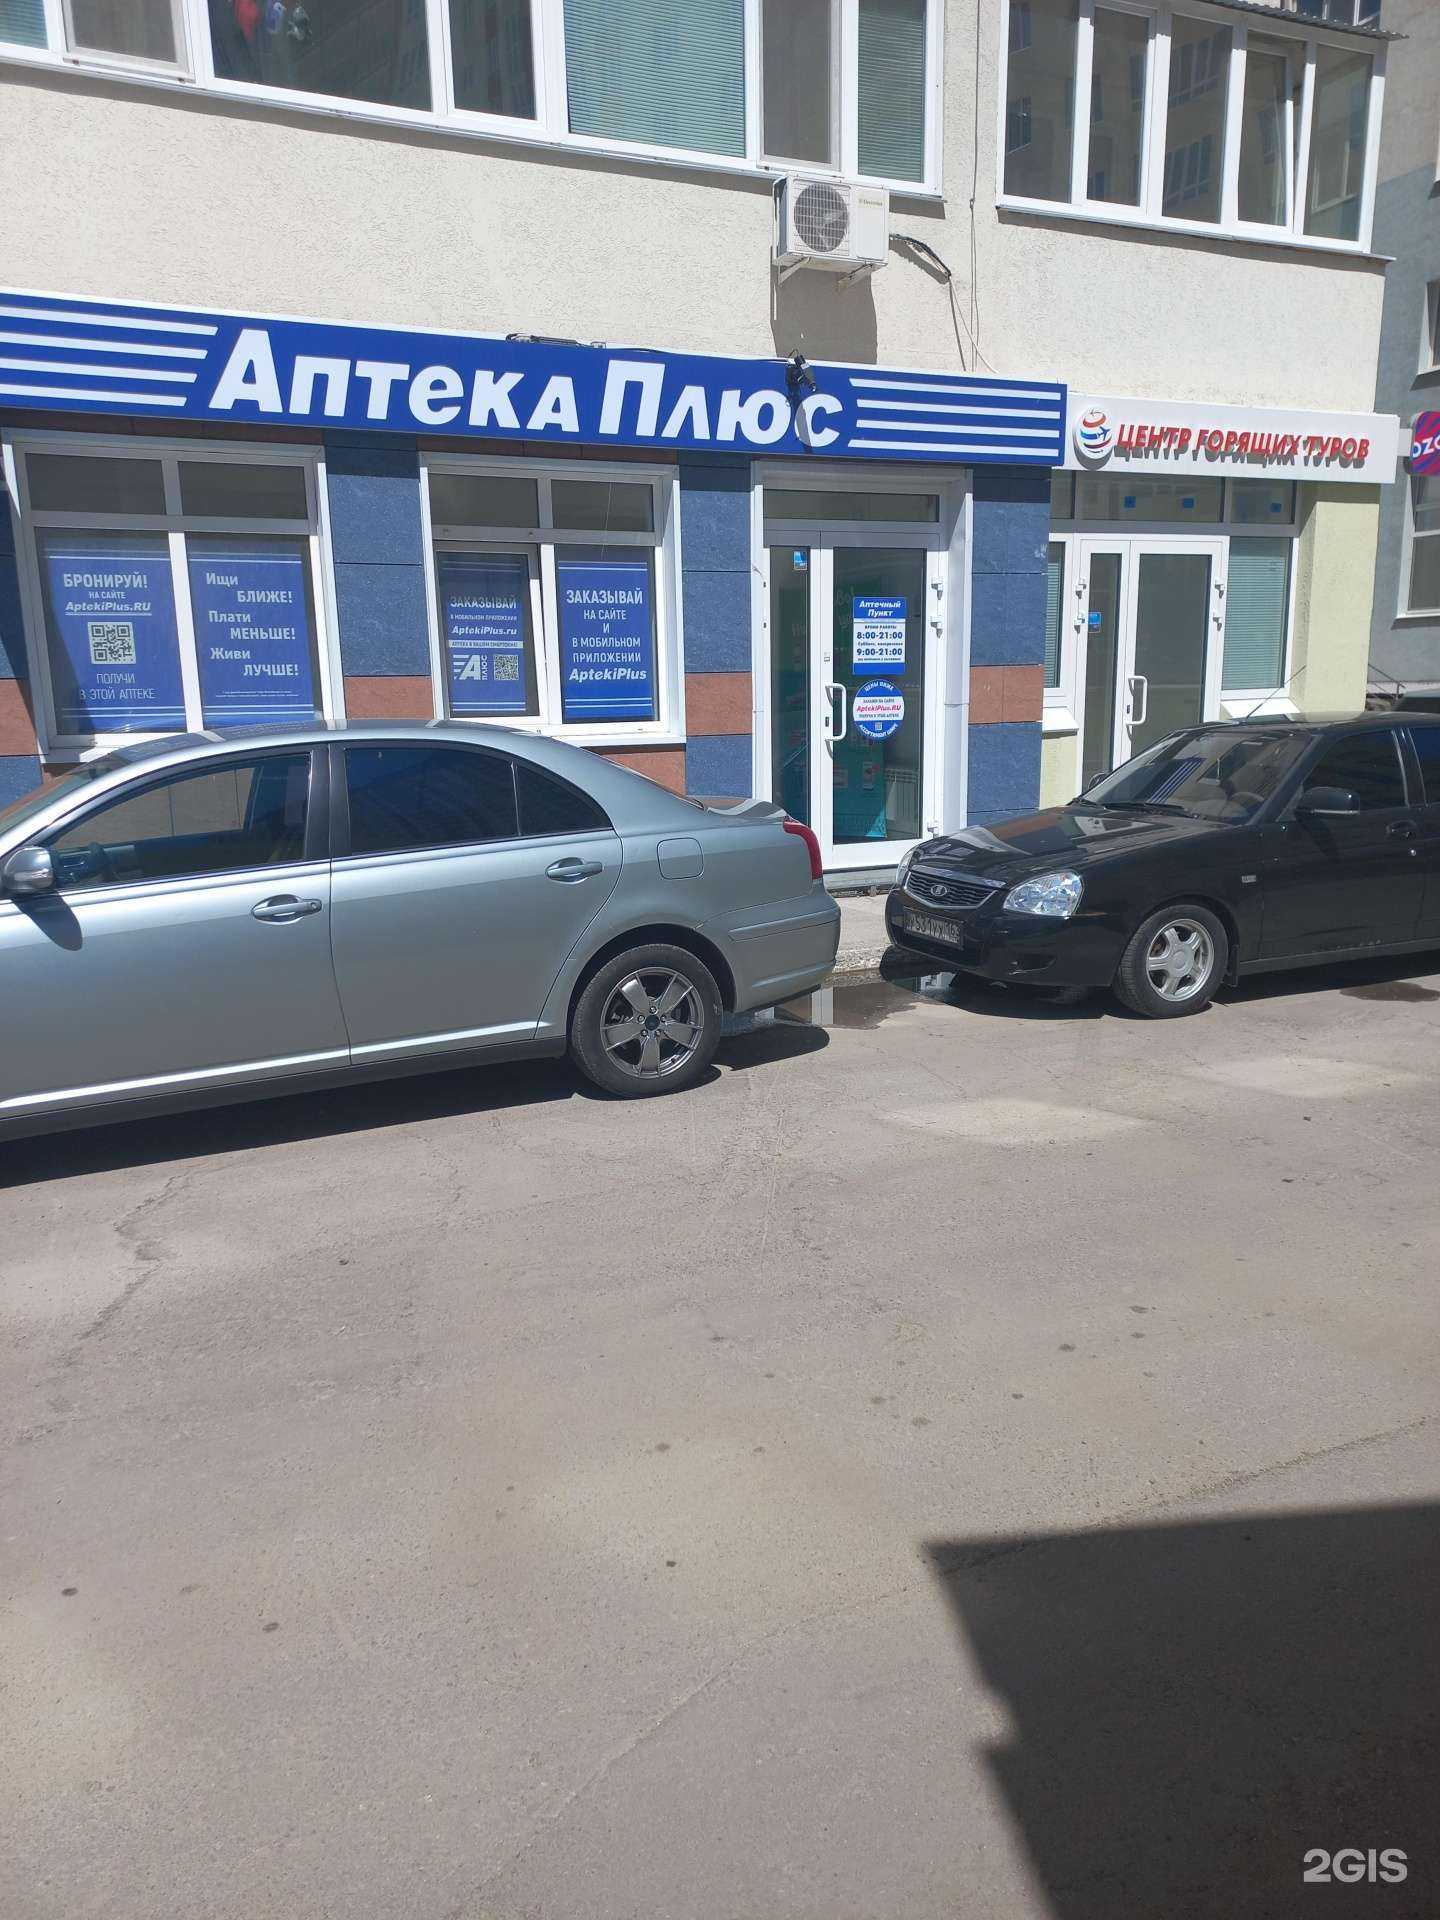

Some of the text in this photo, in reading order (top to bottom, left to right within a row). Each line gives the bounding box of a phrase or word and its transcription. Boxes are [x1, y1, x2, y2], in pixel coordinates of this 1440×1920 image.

[1117, 424, 1370, 460] ЦЕНТР ГОРЯЩИХ ТУРОВ
[63, 572, 148, 588] БРОНИРУЙ!
[206, 572, 239, 587] Ищи
[89, 591, 100, 599] НА
[237, 590, 293, 603] БЛИЖЕ!
[566, 588, 643, 604] ЗАКАЗЫВАЙ
[65, 601, 151, 613] AptekiPlus.RU
[450, 594, 517, 609] ЗАКАЗЫВАЙ
[859, 600, 901, 608] Аптечный
[208, 610, 251, 623] Плати
[584, 608, 627, 620] НА САЙТЕ
[868, 609, 894, 618] Пункт
[230, 627, 296, 640] МЕНЬШЕ!
[451, 625, 518, 636] AptekiPlus.ru
[603, 623, 610, 633] И
[857, 631, 903, 639] 8:00-21:00
[572, 637, 641, 648] В МОБИЛЬНОМ
[210, 647, 251, 660] Живи
[573, 652, 641, 663] ПРИЛОЖЕНИИ
[857, 648, 902, 656] 9:00-21:00
[243, 664, 299, 676] ЛУЧШЕ!
[569, 667, 647, 683] AptekiPlus
[96, 673, 136, 685] ПОЛУЧИ
[90, 686, 116, 700] ЭТОЙ
[119, 688, 156, 700] АПТЕКЕ
